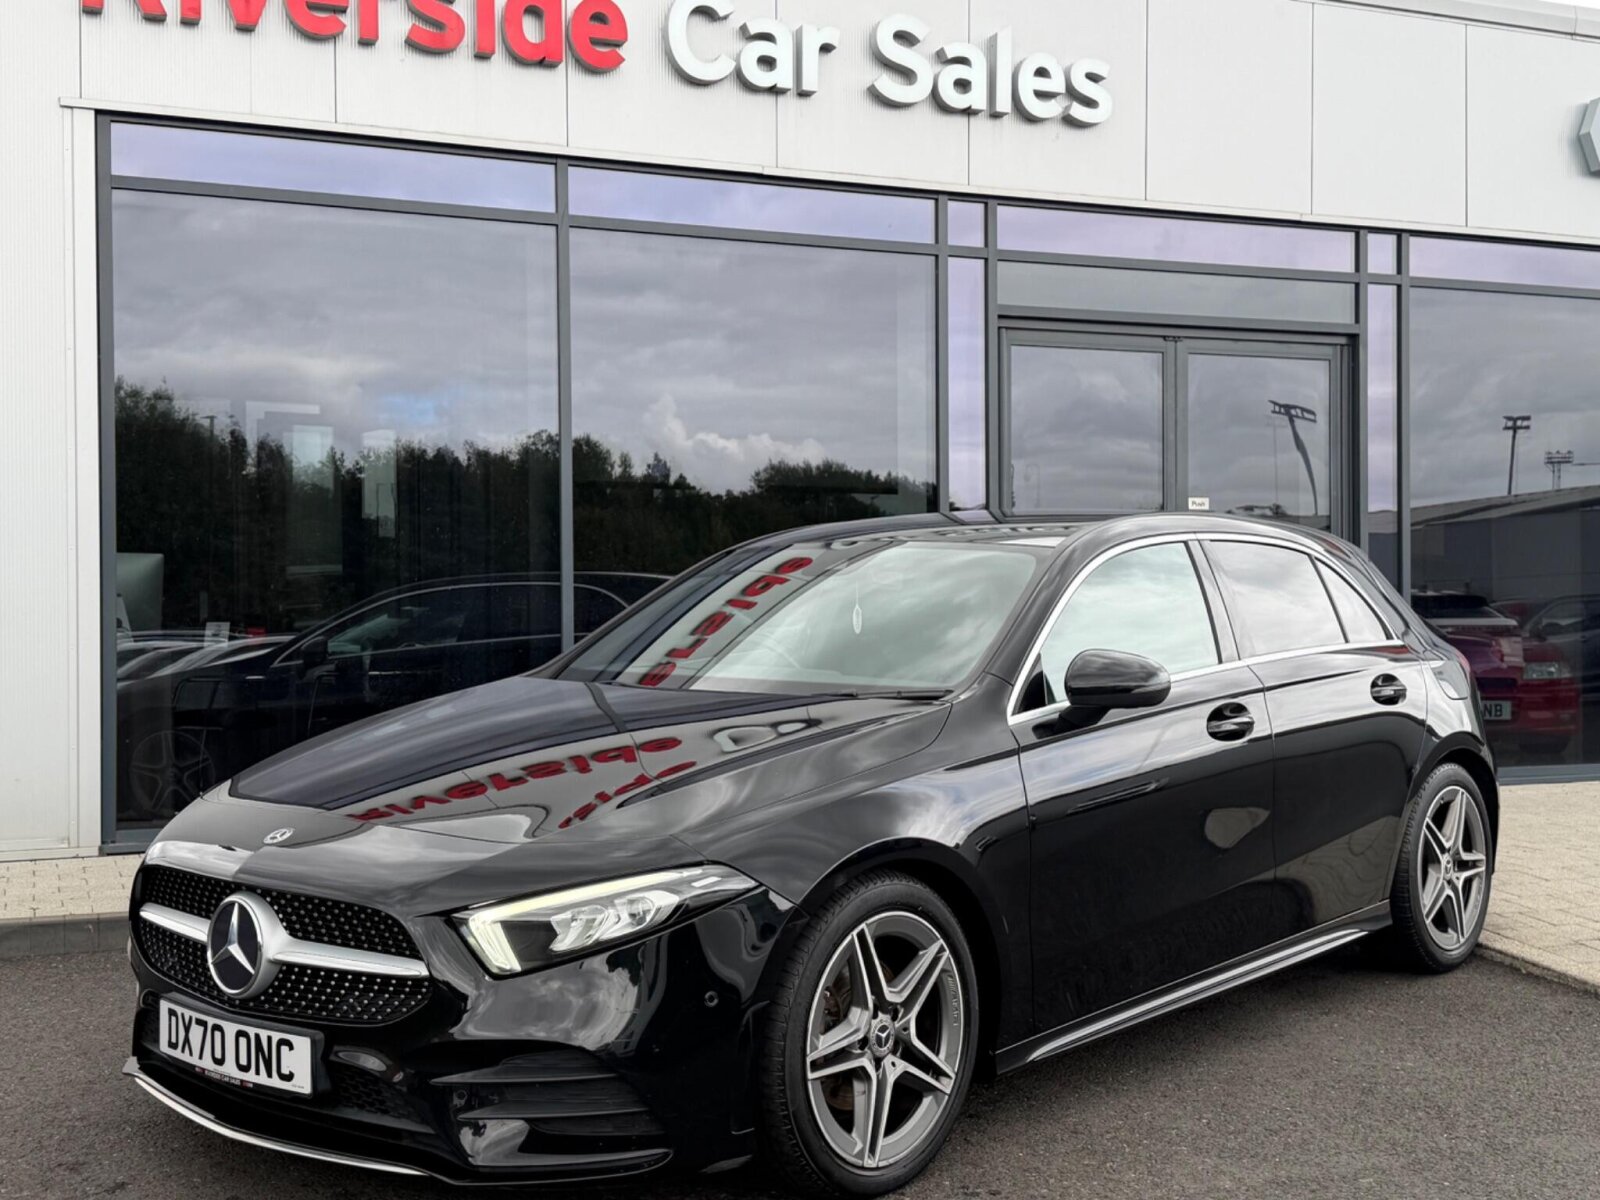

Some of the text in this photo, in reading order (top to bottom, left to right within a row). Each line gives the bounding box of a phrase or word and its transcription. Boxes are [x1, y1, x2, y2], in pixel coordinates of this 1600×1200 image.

[82, 0, 1113, 126] erside Car Sales
[167, 1007, 295, 1083] DX70 ONC
